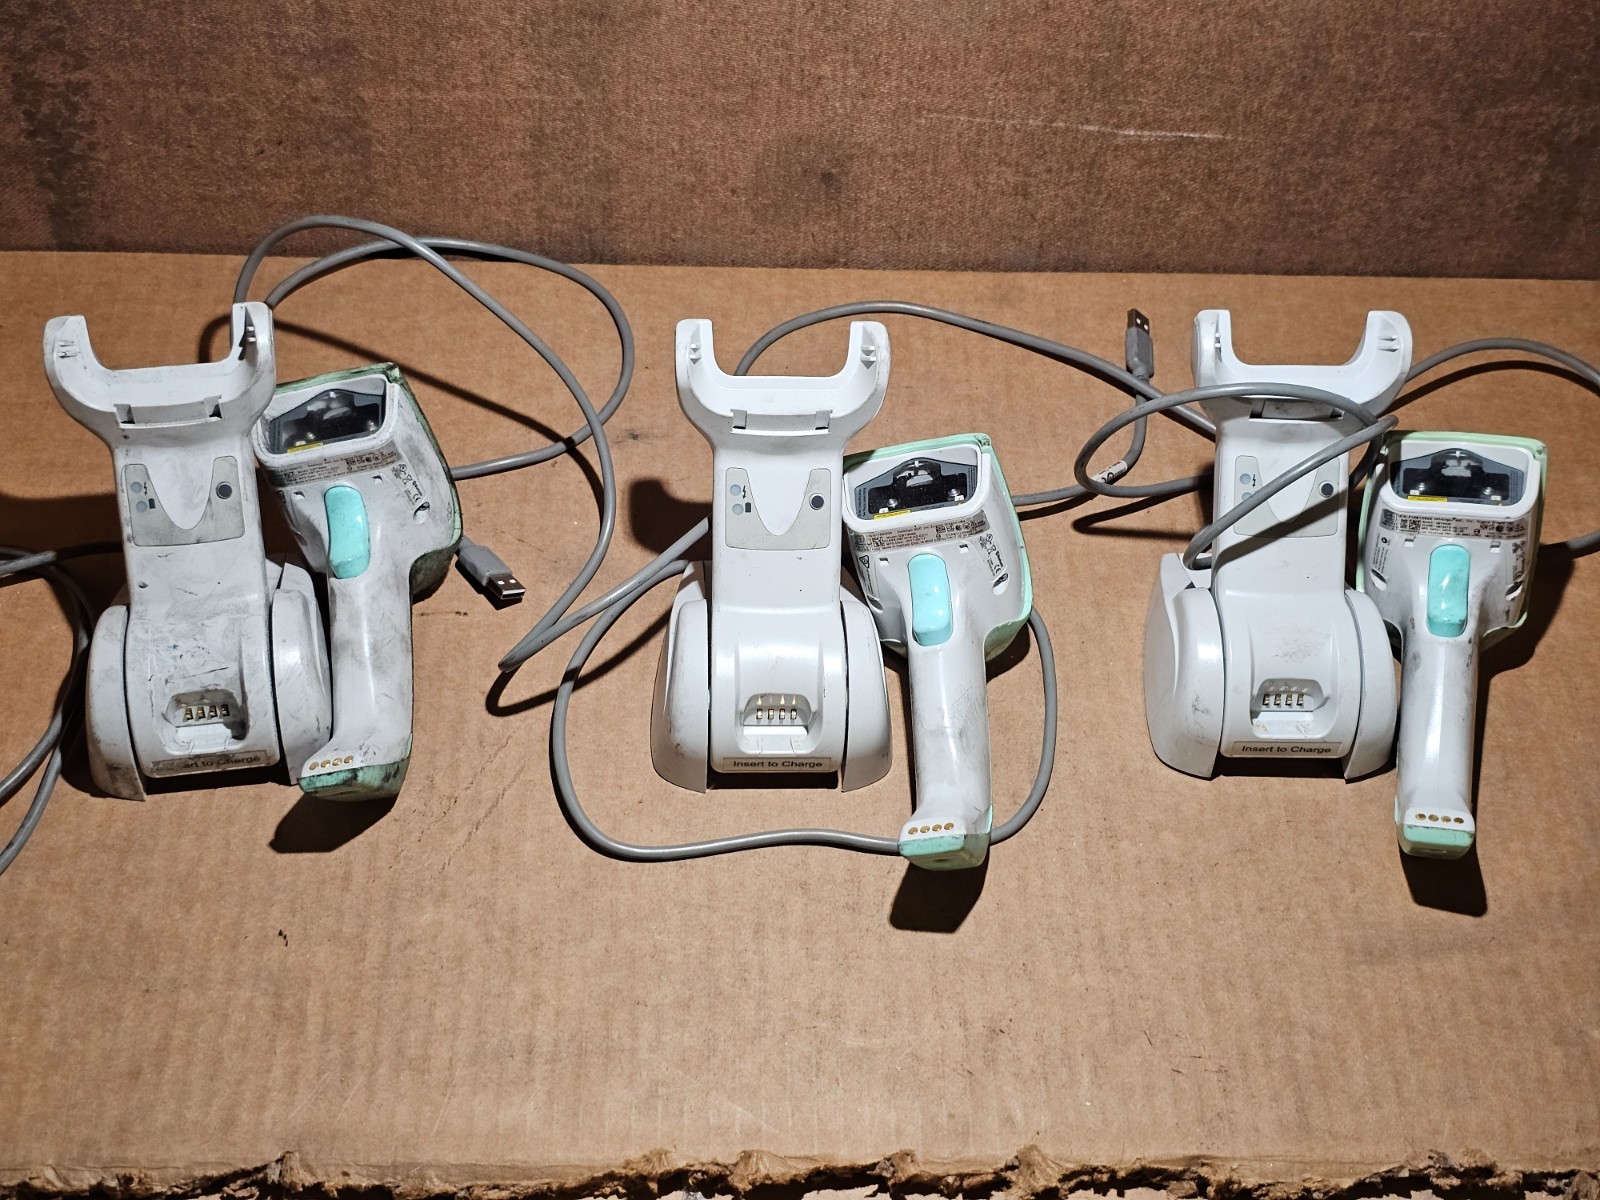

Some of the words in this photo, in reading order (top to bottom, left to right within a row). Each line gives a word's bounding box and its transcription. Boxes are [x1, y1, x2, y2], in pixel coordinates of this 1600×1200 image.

[1276, 745, 1287, 753] to
[1290, 745, 1332, 754] Charge
[781, 760, 823, 768] Charge
